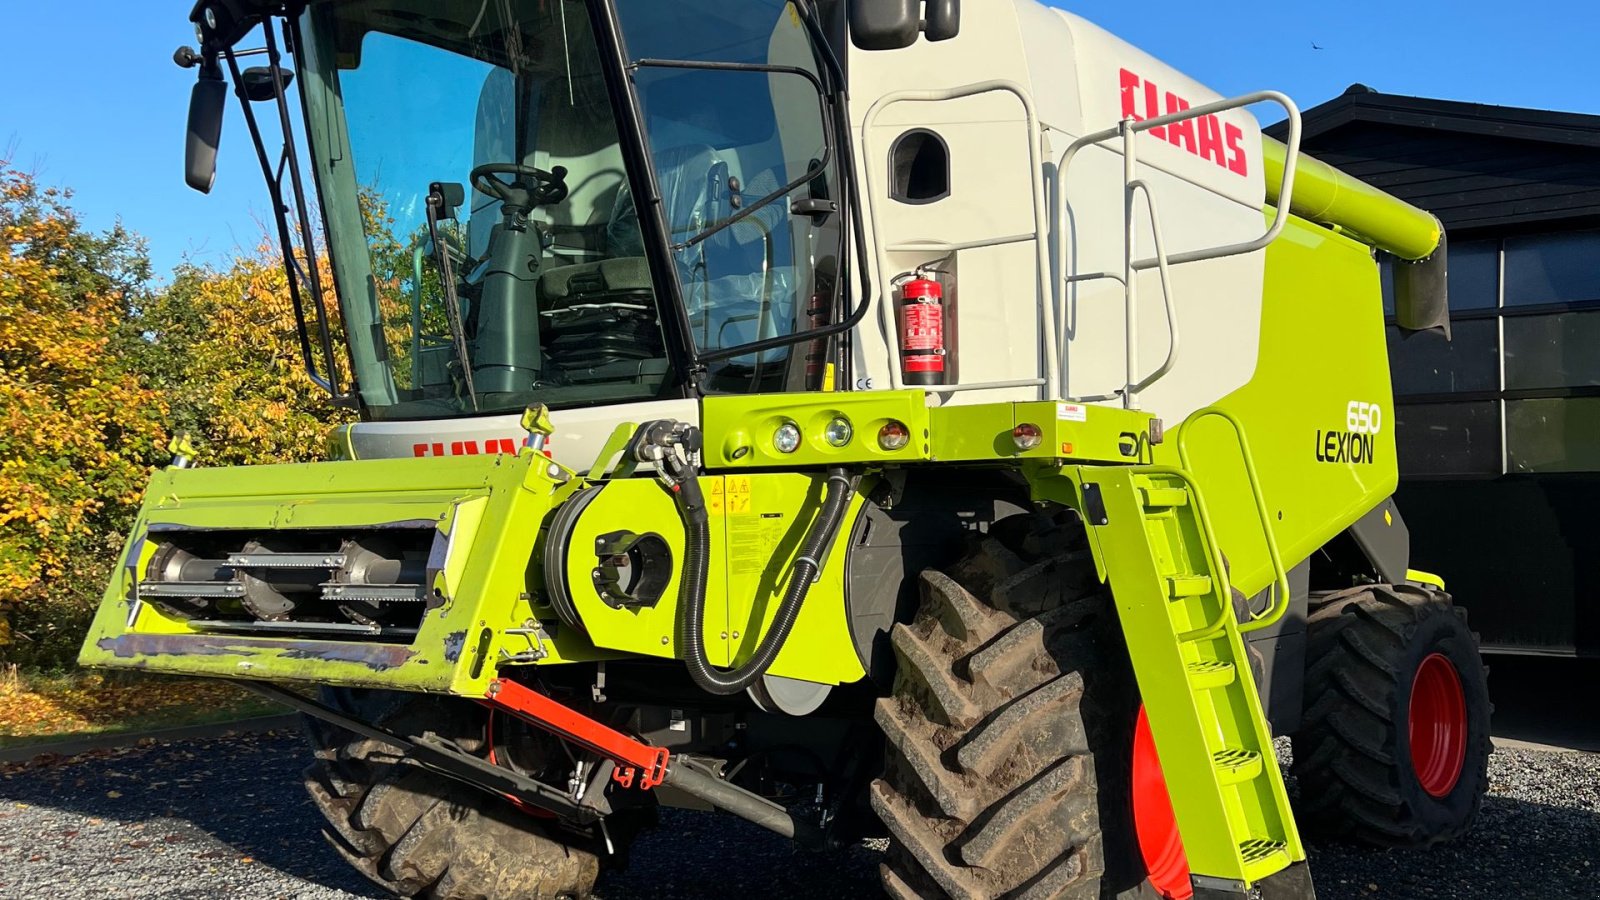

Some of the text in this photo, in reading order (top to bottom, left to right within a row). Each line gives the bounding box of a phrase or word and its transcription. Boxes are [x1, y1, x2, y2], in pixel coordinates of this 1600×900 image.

[1119, 67, 1248, 178] CLAAS
[1346, 400, 1381, 435] 650
[1316, 429, 1374, 464] LEXION
